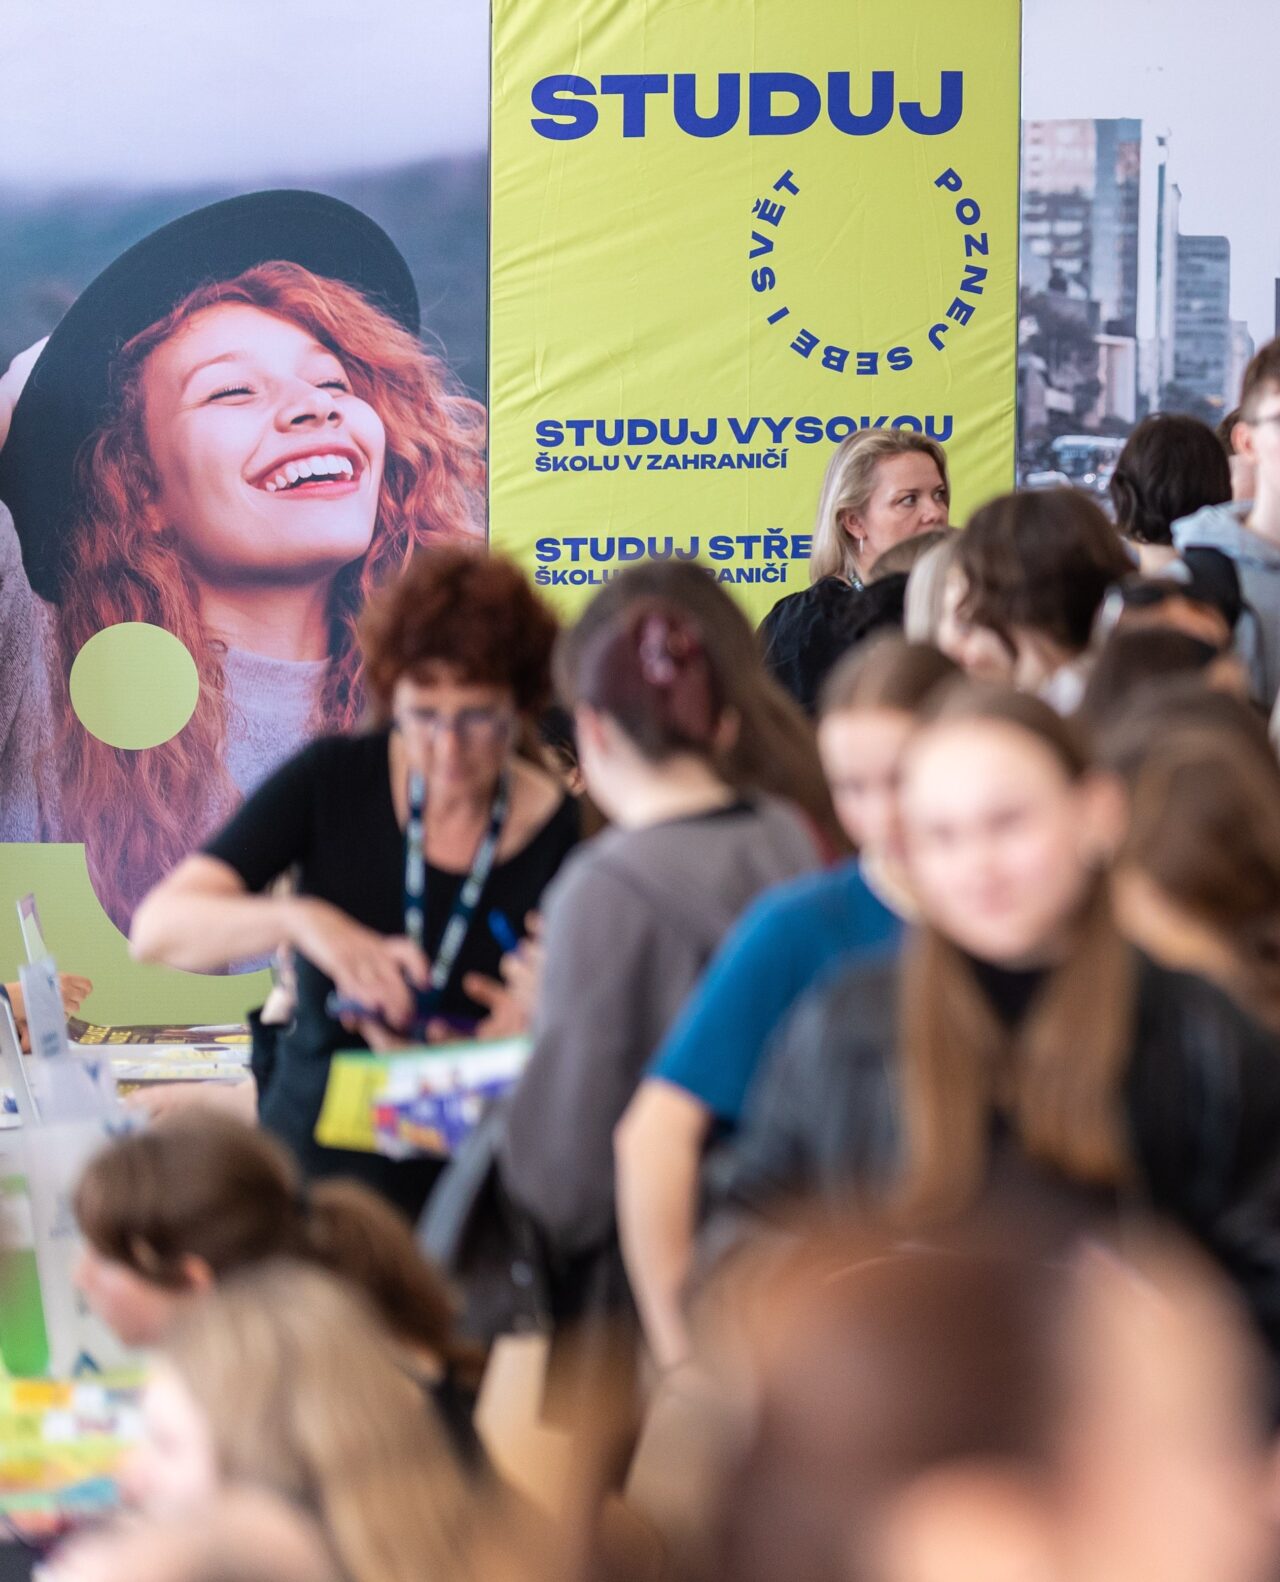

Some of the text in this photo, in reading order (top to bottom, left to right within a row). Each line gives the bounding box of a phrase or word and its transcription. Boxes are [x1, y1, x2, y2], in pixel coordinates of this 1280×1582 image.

[530, 71, 963, 140] STUDUJ
[749, 168, 989, 375] POZNEJ SEBE I SVĚT
[535, 418, 717, 447] STUDUJ
[535, 448, 788, 472] ŠKOLU V ZAHRANIČÍ
[535, 528, 813, 562] STUDUJ STŘE
[706, 563, 786, 583] ANIČÍ
